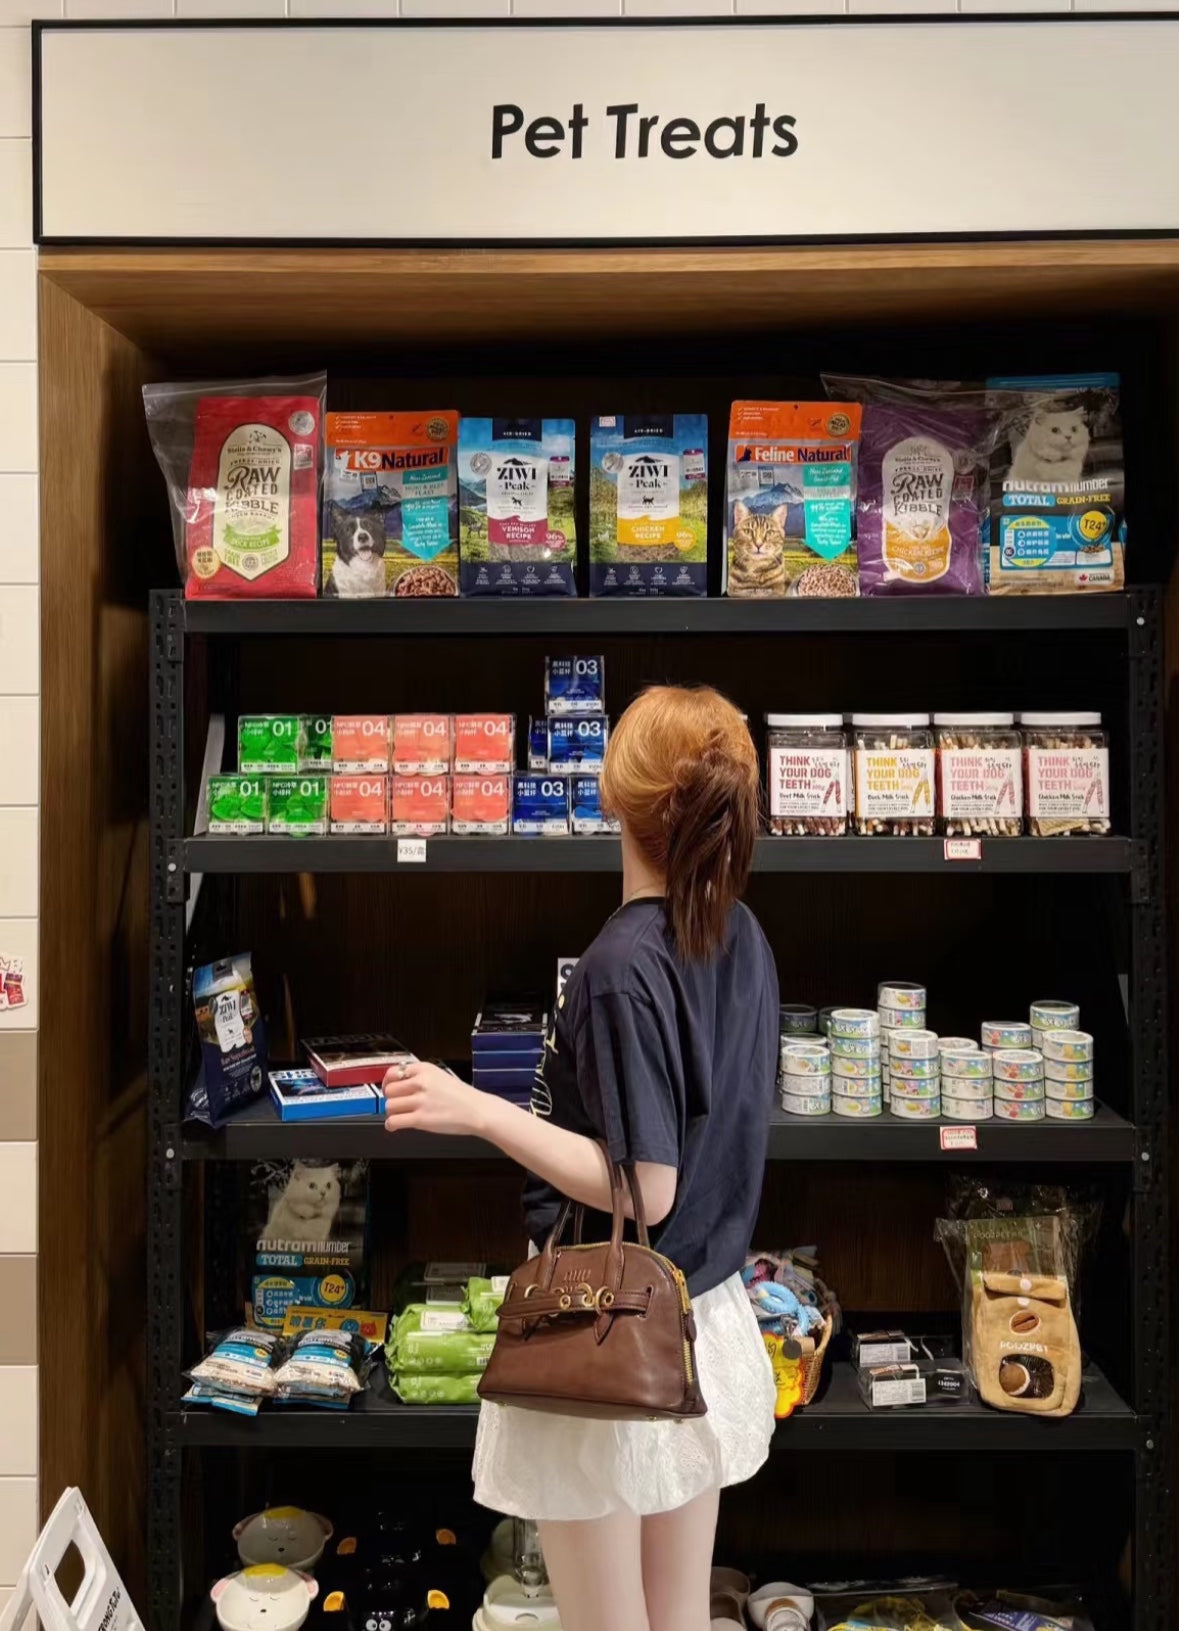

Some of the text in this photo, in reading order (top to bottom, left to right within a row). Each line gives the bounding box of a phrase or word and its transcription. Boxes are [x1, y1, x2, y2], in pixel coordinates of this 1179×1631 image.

[492, 102, 799, 159] Pet Treats
[755, 446, 848, 461] Feline Natural
[497, 467, 536, 480] ZIWI
[628, 465, 668, 478] ZIWI
[224, 466, 281, 494] RAW
[504, 481, 530, 490] Peak
[636, 479, 661, 488] Peak
[890, 472, 943, 496] RAW
[893, 488, 943, 504] COATED
[1009, 493, 1111, 506] TOTAL GRAIN-FREE
[894, 503, 942, 517] KIBBLE
[506, 532, 532, 540] RECIPE
[576, 659, 598, 675] 03
[272, 721, 292, 736] 01
[362, 720, 385, 736] 04
[423, 720, 446, 736] 04
[484, 720, 507, 736] 04
[578, 721, 601, 737] 03
[779, 755, 810, 766] THINK
[867, 757, 897, 766] THINK
[951, 757, 982, 767] THINK
[1038, 756, 1070, 766] THINK
[779, 768, 831, 778] YOUR DOG
[867, 768, 919, 778] YOUR DOG
[951, 768, 1004, 778] YOUR DOG
[1038, 768, 1092, 778] YOUR DOG
[240, 781, 259, 796] 01
[300, 781, 320, 796] 01
[359, 781, 382, 797] 04
[421, 781, 443, 797] 04
[481, 781, 504, 797] 04
[541, 781, 564, 797] 03
[779, 779, 811, 789] TEETH
[867, 780, 899, 790] TEETH
[950, 780, 984, 791] TEETH
[1038, 780, 1071, 790] TEETH
[219, 1000, 237, 1015] ZIWI
[261, 1254, 350, 1266] TOTAL GRAIN-FREE
